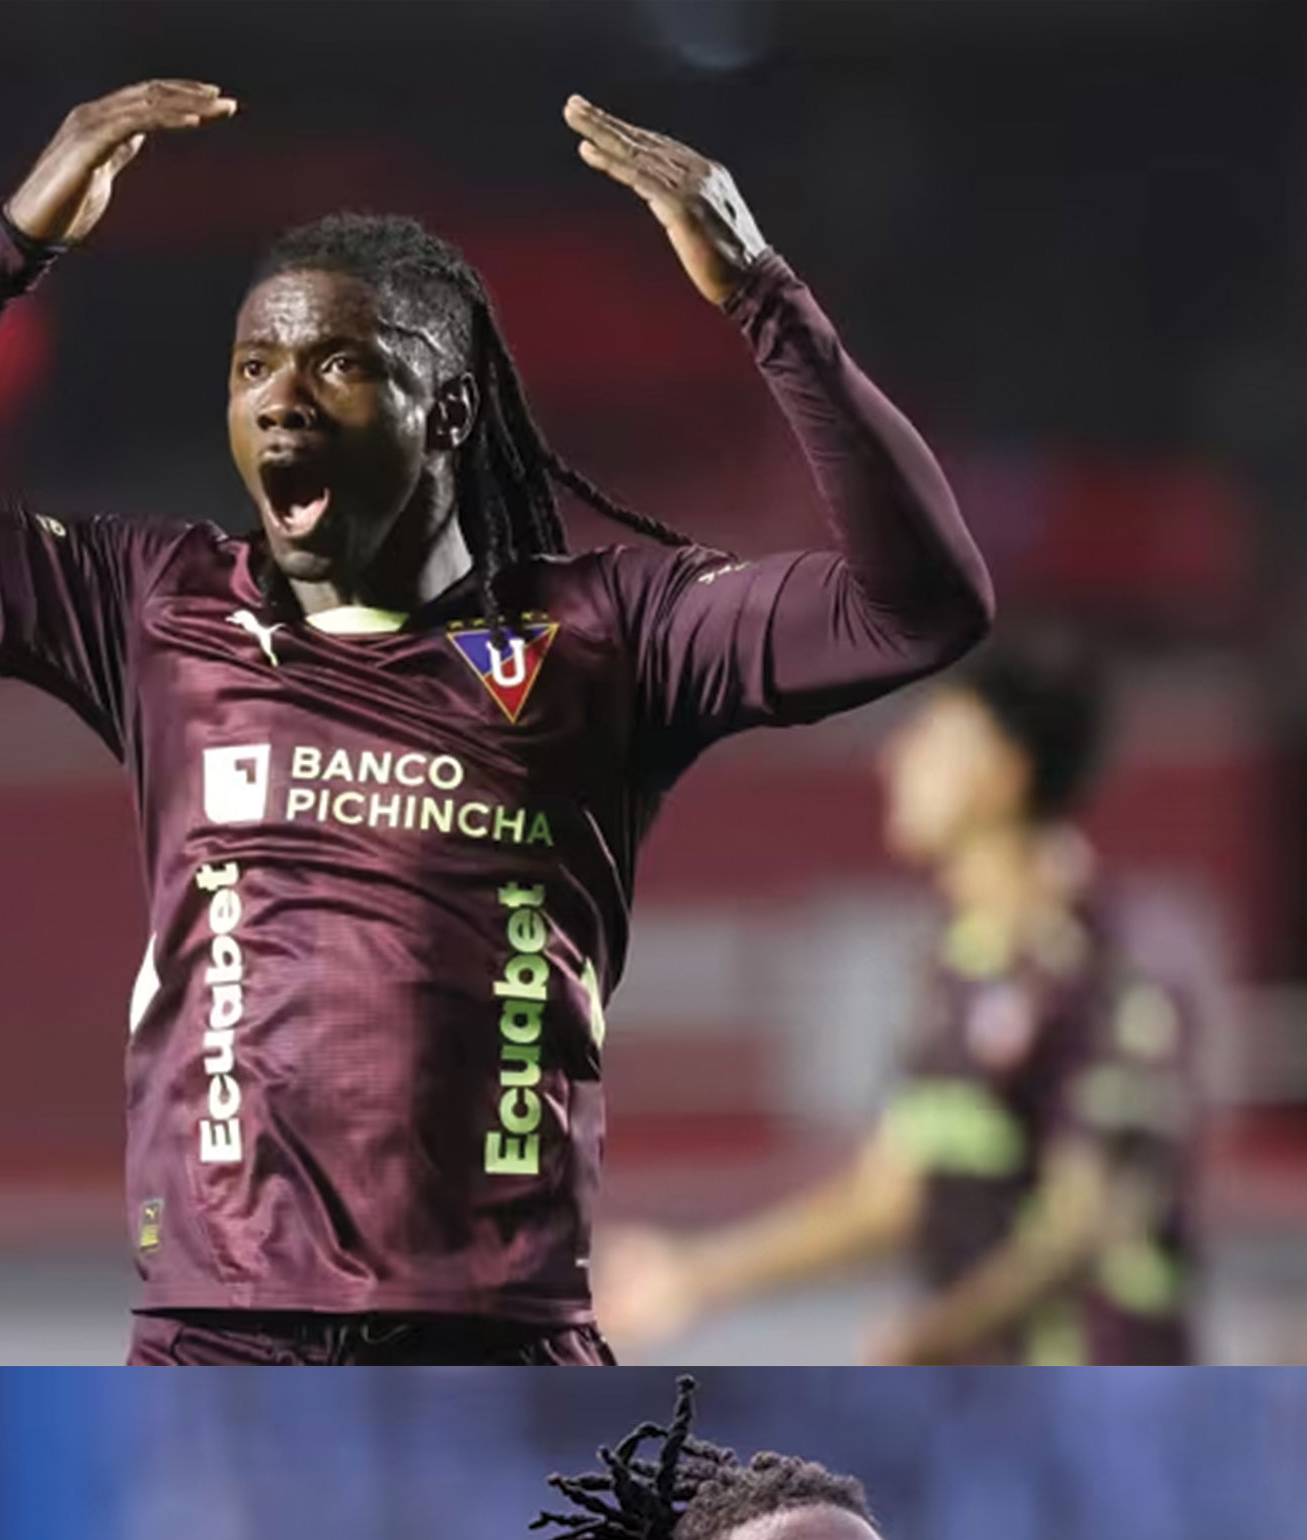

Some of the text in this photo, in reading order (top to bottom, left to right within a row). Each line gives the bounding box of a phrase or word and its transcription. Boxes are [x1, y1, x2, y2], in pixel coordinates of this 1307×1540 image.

[485, 637, 526, 688] U
[290, 745, 465, 791] BANCO
[284, 787, 555, 848] PICHINCHA
[195, 862, 244, 1164] Ecuabet
[483, 881, 548, 1176] Ecuabet
